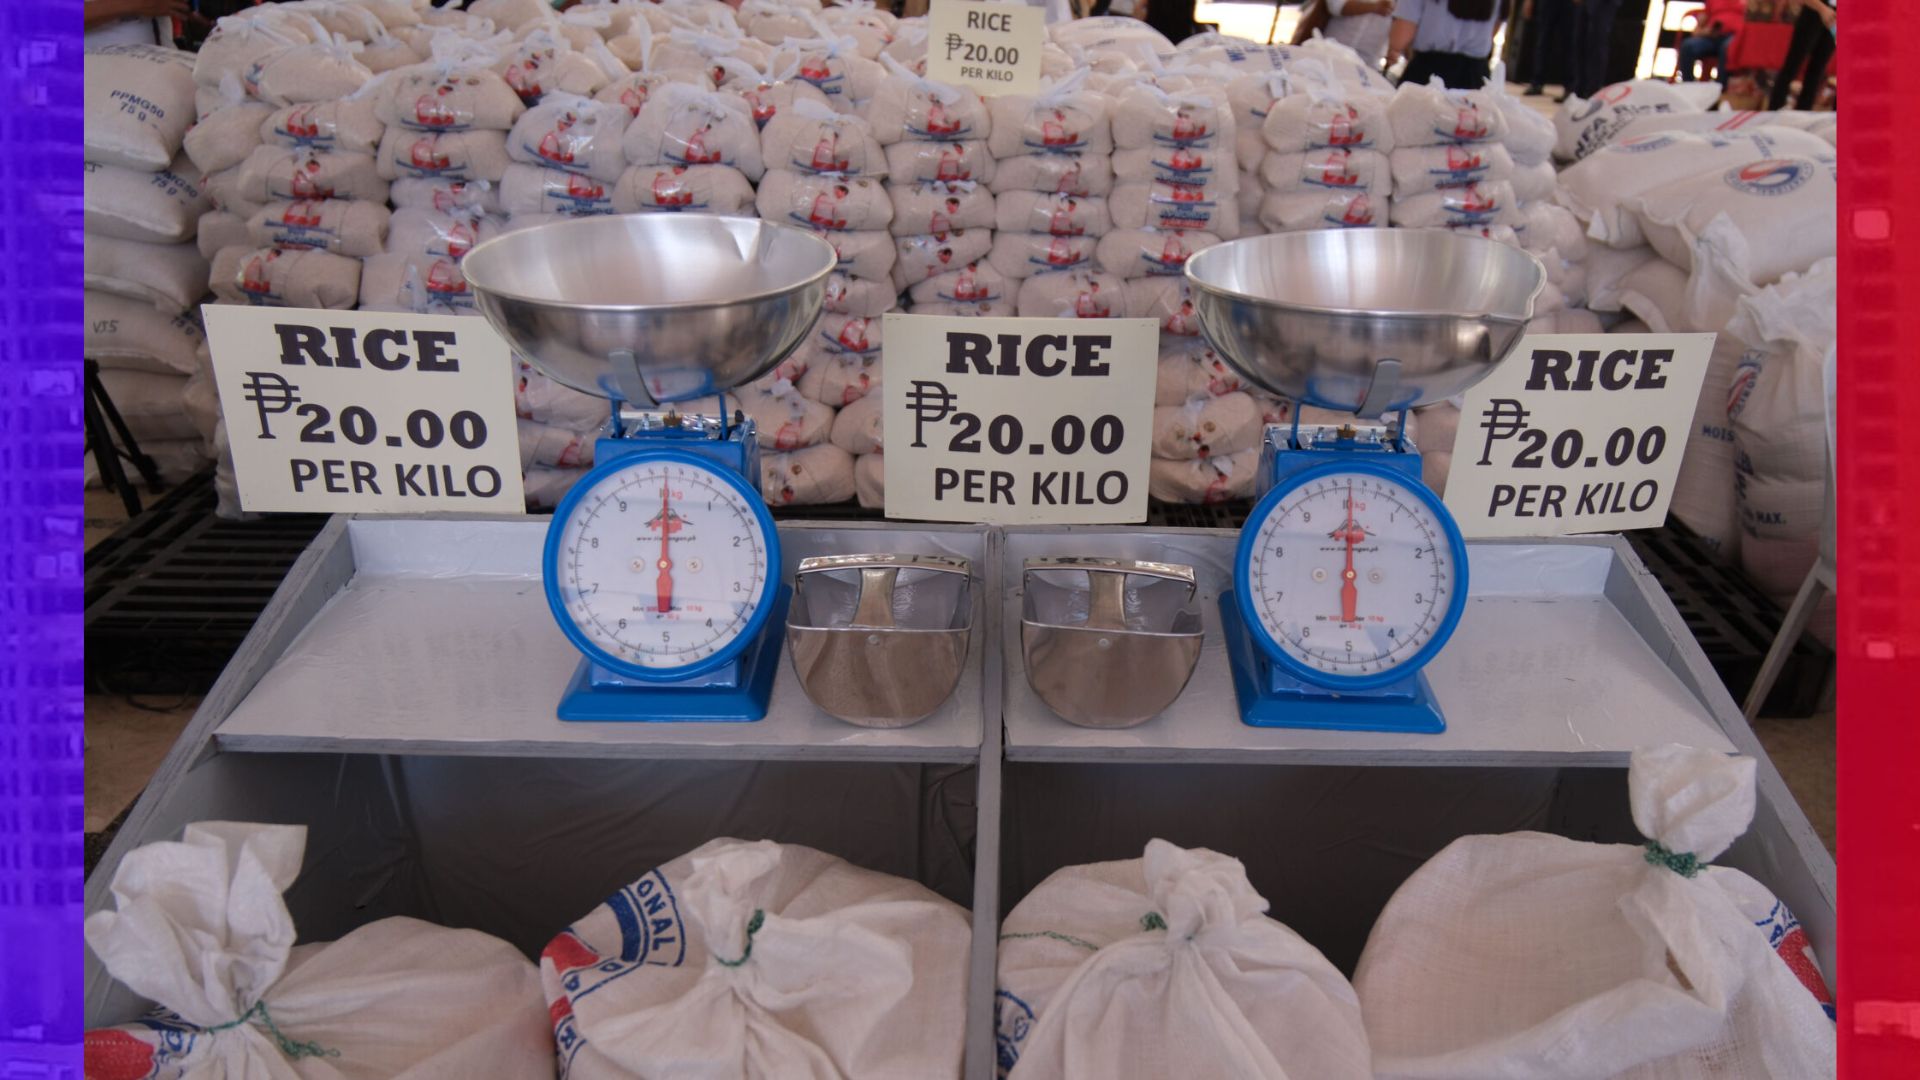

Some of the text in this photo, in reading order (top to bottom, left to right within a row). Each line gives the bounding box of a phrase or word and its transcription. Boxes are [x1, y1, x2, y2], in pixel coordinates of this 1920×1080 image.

[968, 10, 1012, 32] RICE
[944, 33, 1019, 65] ₱20.00
[961, 66, 1014, 82] PER KILO
[110, 89, 165, 119] PPMG50
[120, 102, 135, 114] 75
[274, 323, 460, 372] RICE
[946, 332, 1112, 377] RICE
[1525, 349, 1674, 390] RICE
[243, 372, 488, 450] ₱20.00
[906, 380, 1124, 454] ₱20.00
[1476, 399, 1666, 468] ₱20.00
[290, 459, 502, 498] PER KILO
[935, 468, 1128, 505] PER KILO
[672, 489, 682, 500] kg
[1488, 480, 1658, 518] PER KILO
[620, 502, 628, 512] 9
[1354, 500, 1366, 511] kg
[1304, 513, 1310, 522] 9
[591, 538, 599, 548] 8
[733, 536, 740, 547] 2
[1276, 547, 1284, 558] 8
[1415, 548, 1422, 558] 2
[592, 584, 600, 594] 7
[733, 582, 740, 592] 3
[1276, 592, 1284, 602] 7
[1415, 593, 1422, 604] 3
[619, 619, 626, 628] 6
[706, 618, 712, 628] 4
[662, 632, 670, 642] 5
[1302, 628, 1310, 638] 6
[1388, 628, 1394, 638] 4
[1346, 640, 1352, 651] 5
